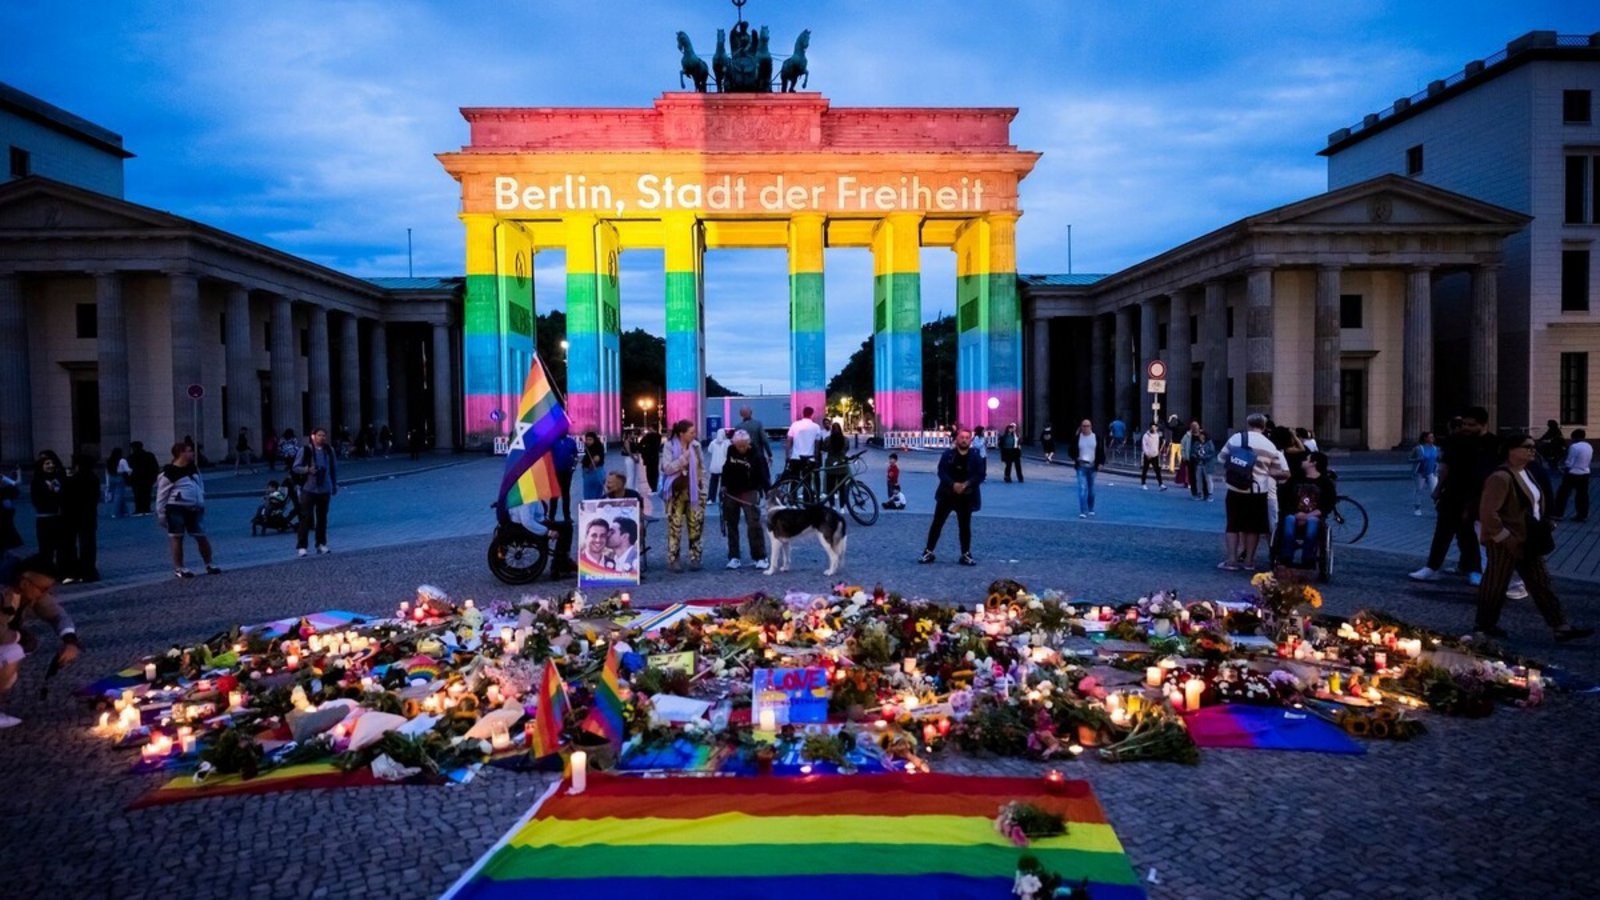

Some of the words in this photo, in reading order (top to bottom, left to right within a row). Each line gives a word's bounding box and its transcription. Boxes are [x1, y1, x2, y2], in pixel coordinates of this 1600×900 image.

[494, 174, 625, 217] Berlin,
[636, 174, 747, 210] Stadt
[758, 175, 826, 210] der
[837, 175, 984, 210] Freiheit
[767, 667, 823, 691] LOVE
